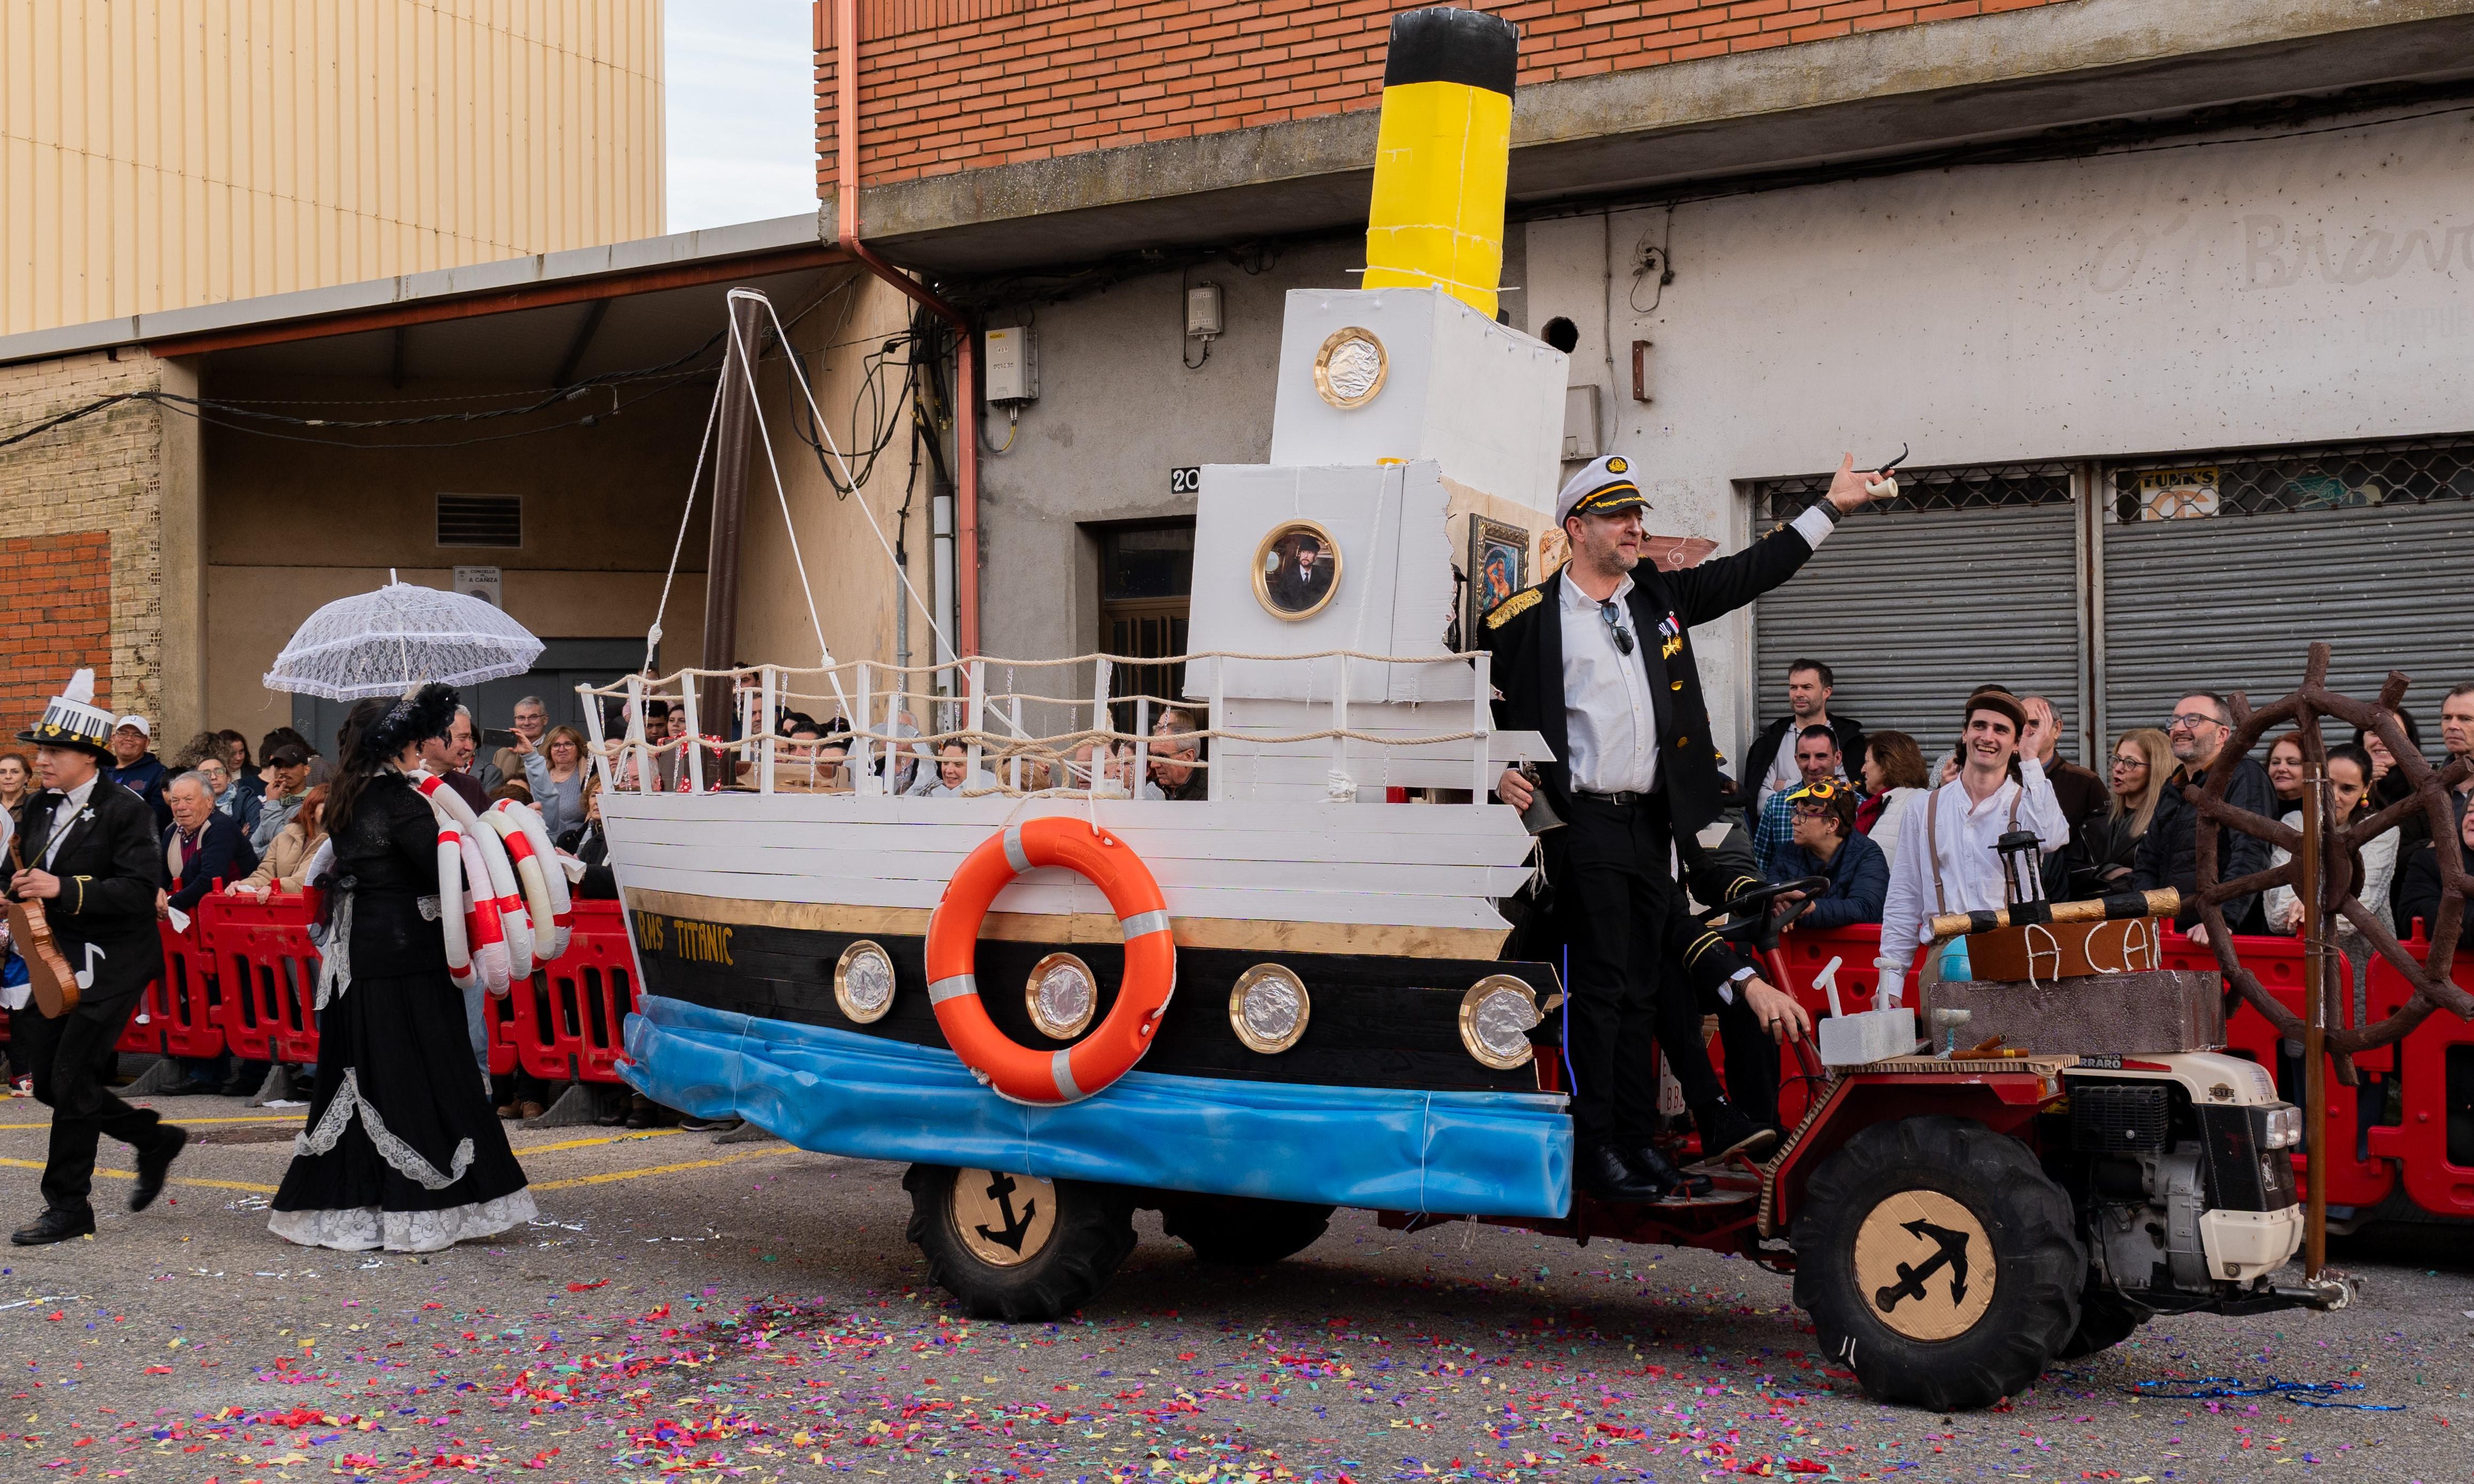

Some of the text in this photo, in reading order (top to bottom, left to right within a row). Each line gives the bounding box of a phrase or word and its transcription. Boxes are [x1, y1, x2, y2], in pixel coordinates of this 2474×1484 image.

[1173, 469, 1200, 492] 20
[637, 911, 733, 966] RMS TITANIC
[2079, 1058, 2121, 1069] RRARO
